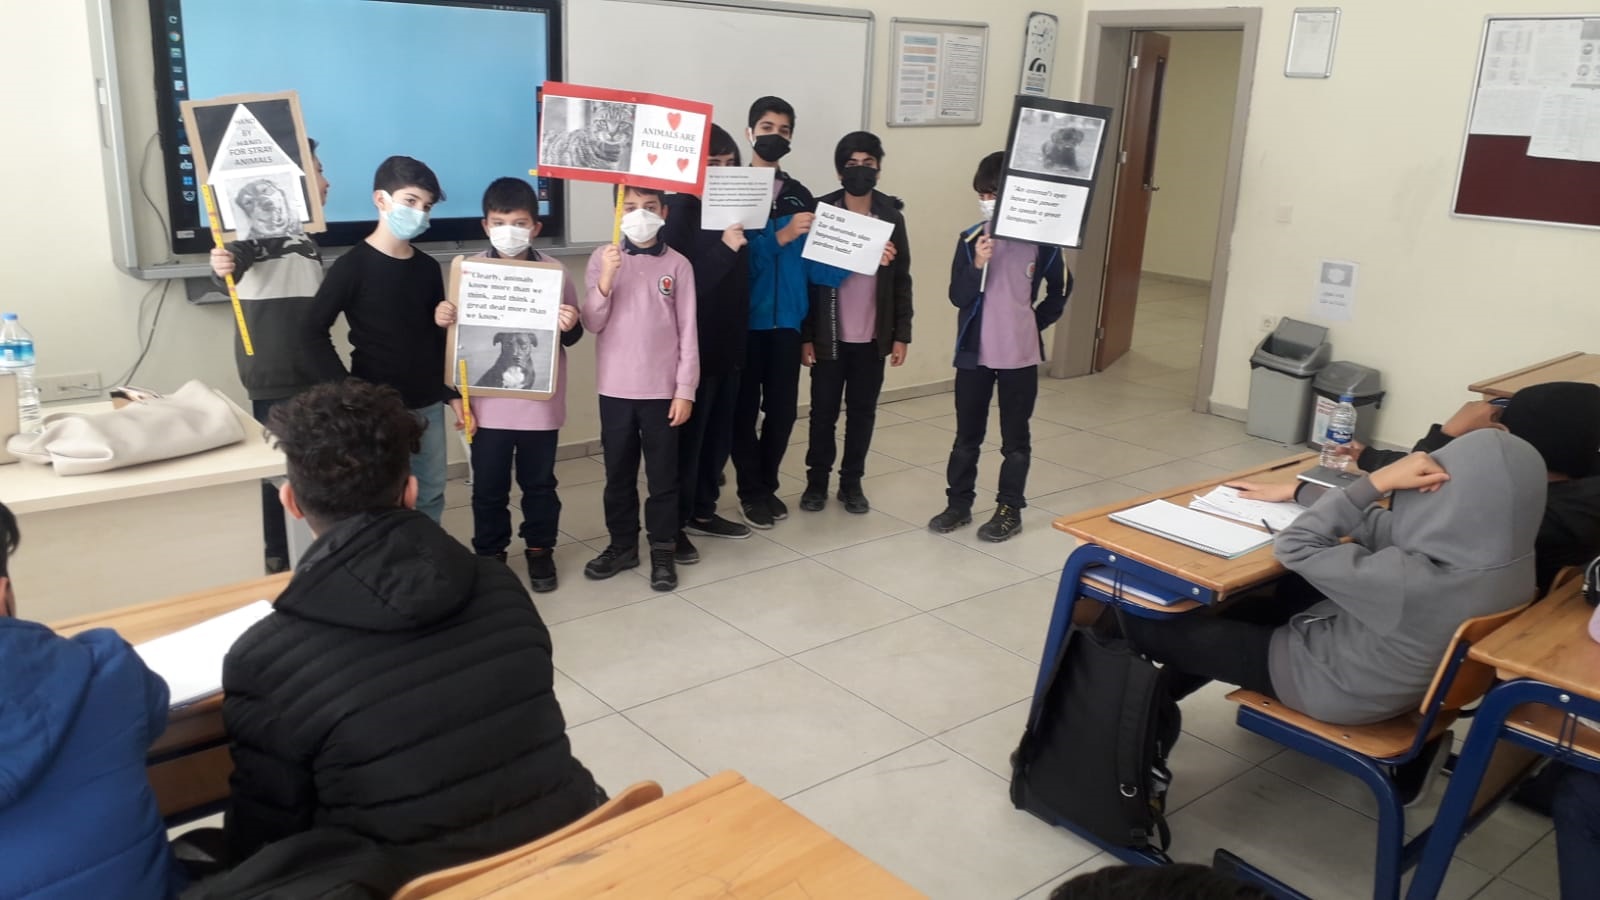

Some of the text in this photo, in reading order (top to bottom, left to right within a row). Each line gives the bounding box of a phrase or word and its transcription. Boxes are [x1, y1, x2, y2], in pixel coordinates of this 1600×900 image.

[642, 127, 697, 142] ANIMALS ARE
[247, 146, 273, 154] STRAY
[641, 140, 697, 155] FULL OF LOVE.
[234, 156, 273, 165] ANIMALS
[468, 281, 488, 290] know
[513, 285, 530, 293] than
[467, 291, 490, 300] think,
[508, 295, 528, 303] think
[466, 302, 487, 311] great
[489, 303, 506, 311] deal
[529, 307, 547, 315] than
